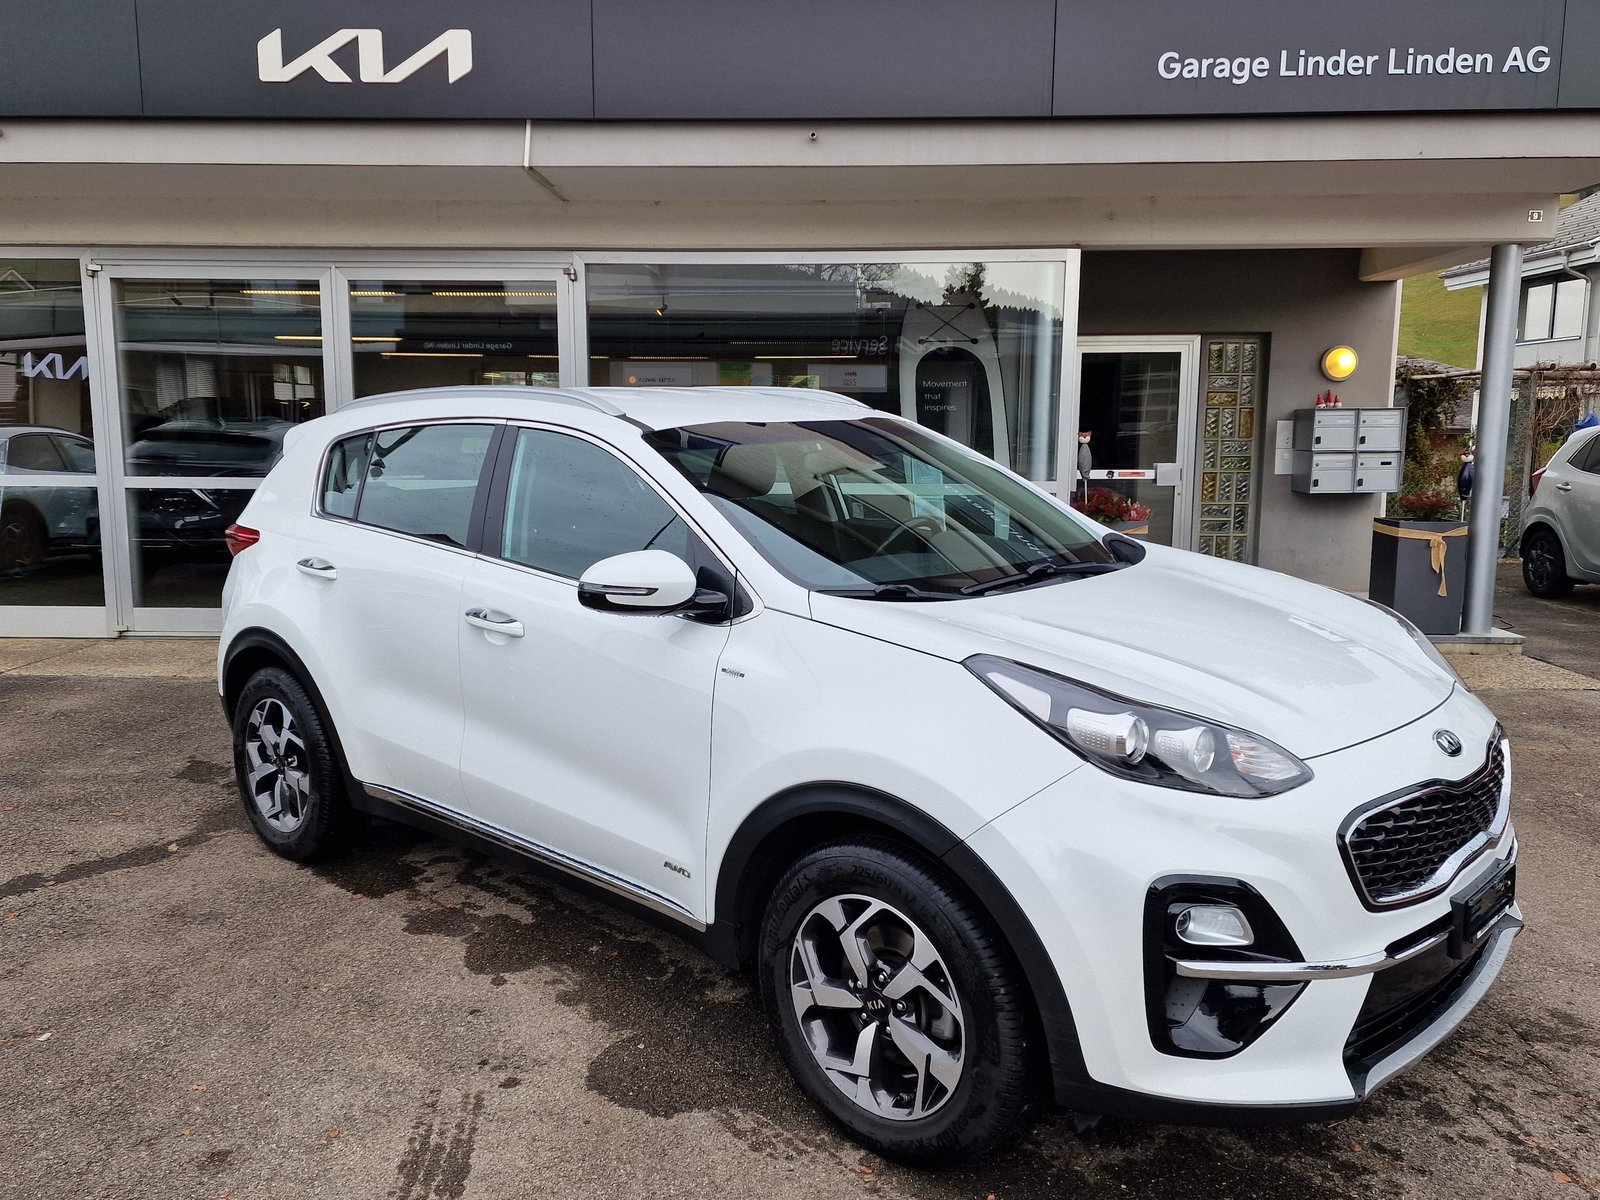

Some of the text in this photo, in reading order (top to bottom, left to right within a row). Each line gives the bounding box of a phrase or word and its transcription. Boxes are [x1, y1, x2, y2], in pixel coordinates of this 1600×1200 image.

[257, 27, 473, 85] KIA
[1157, 45, 1551, 85] Garage Linder Linden AG
[922, 380, 967, 388] Movement
[924, 404, 957, 412] inspires
[866, 999, 885, 1011] KIA
